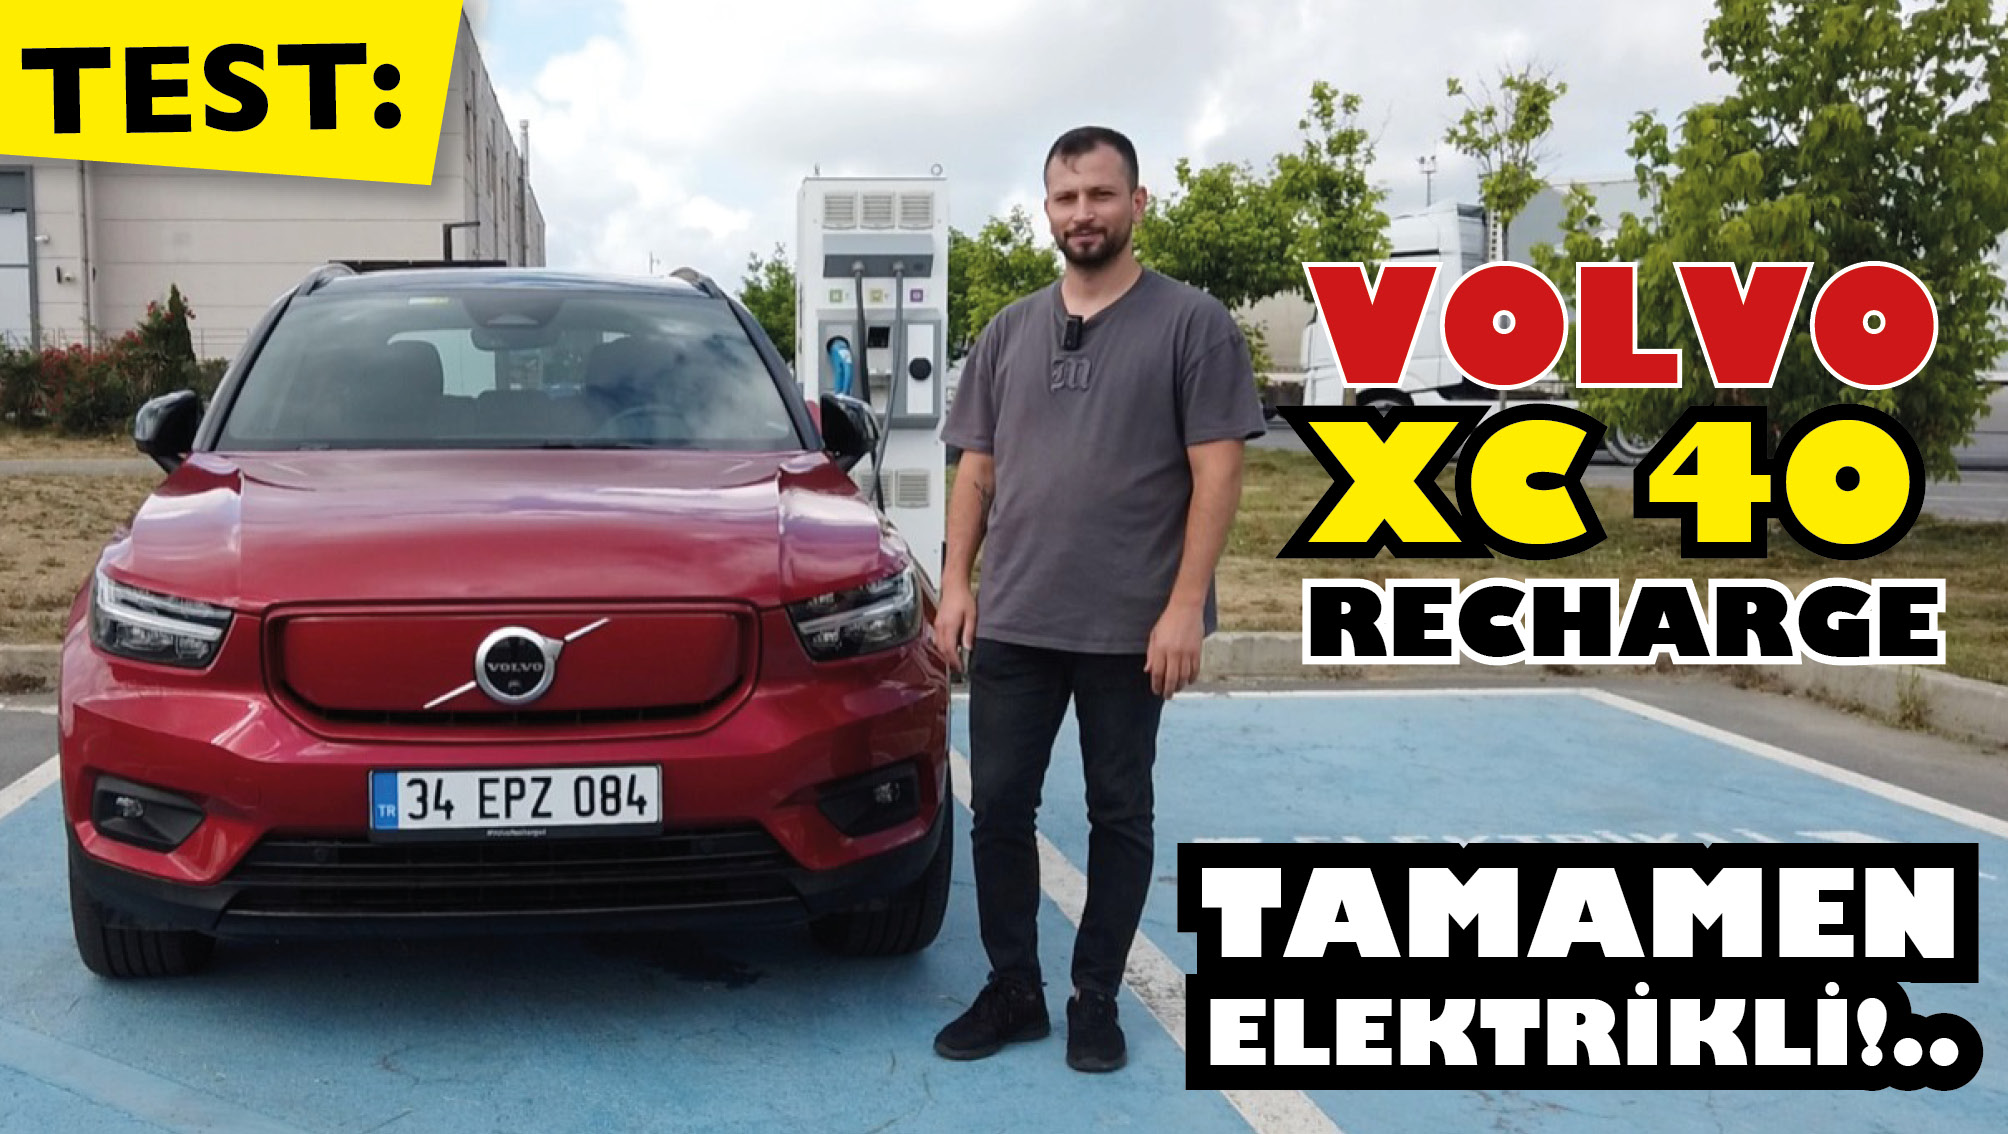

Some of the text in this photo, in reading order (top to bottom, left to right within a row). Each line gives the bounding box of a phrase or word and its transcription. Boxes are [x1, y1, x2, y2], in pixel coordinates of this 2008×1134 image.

[487, 661, 544, 673] VOLVO
[406, 774, 647, 820] 34 EPZ 084
[377, 804, 396, 817] TR
